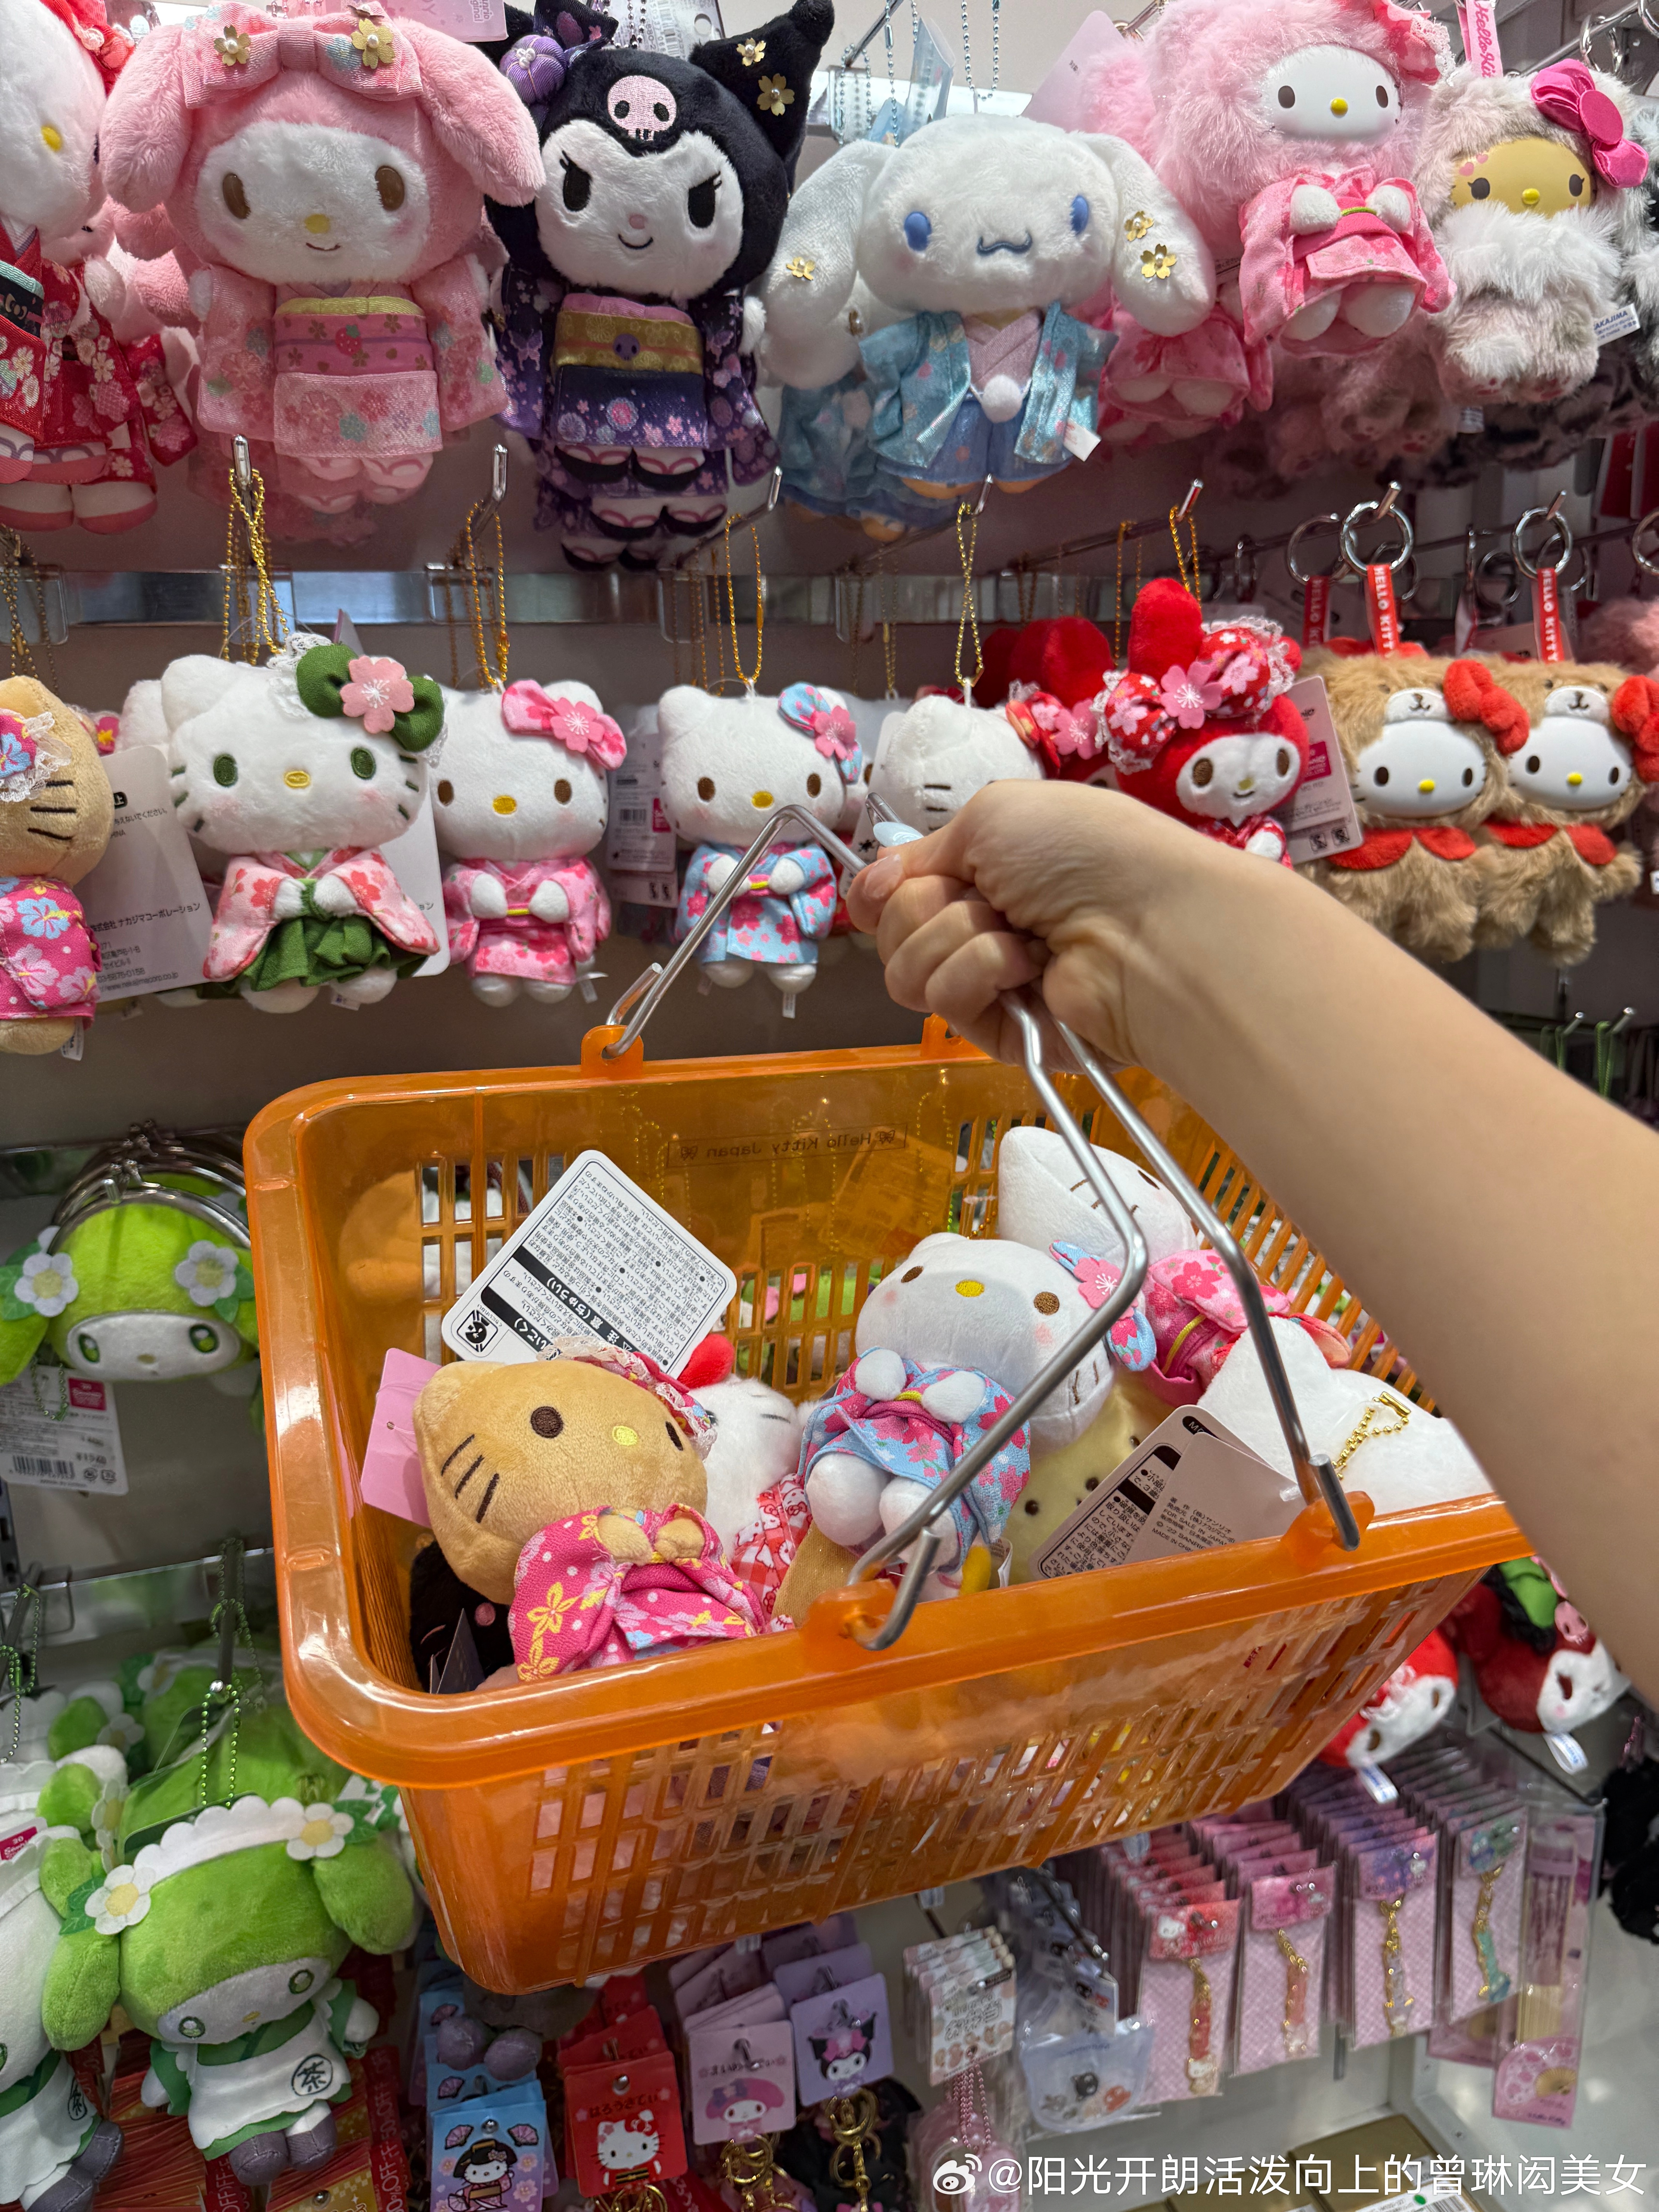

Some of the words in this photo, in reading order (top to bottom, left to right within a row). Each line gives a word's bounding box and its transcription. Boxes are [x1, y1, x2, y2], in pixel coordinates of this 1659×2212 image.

[1594, 311, 1628, 330] AKAJIMA
[1374, 565, 1389, 610] HELLO
[1542, 570, 1554, 612] HELLO
[1545, 617, 1559, 661] KITTY
[118, 903, 200, 927] ナカジマコーポレーション
[518, 1299, 564, 1341] 読みください。
[1151, 1527, 1170, 1540] MADE
[1162, 1508, 1177, 1519] FOR
[1178, 1517, 1196, 1530] SALE
[297, 2060, 327, 2092] 茶
